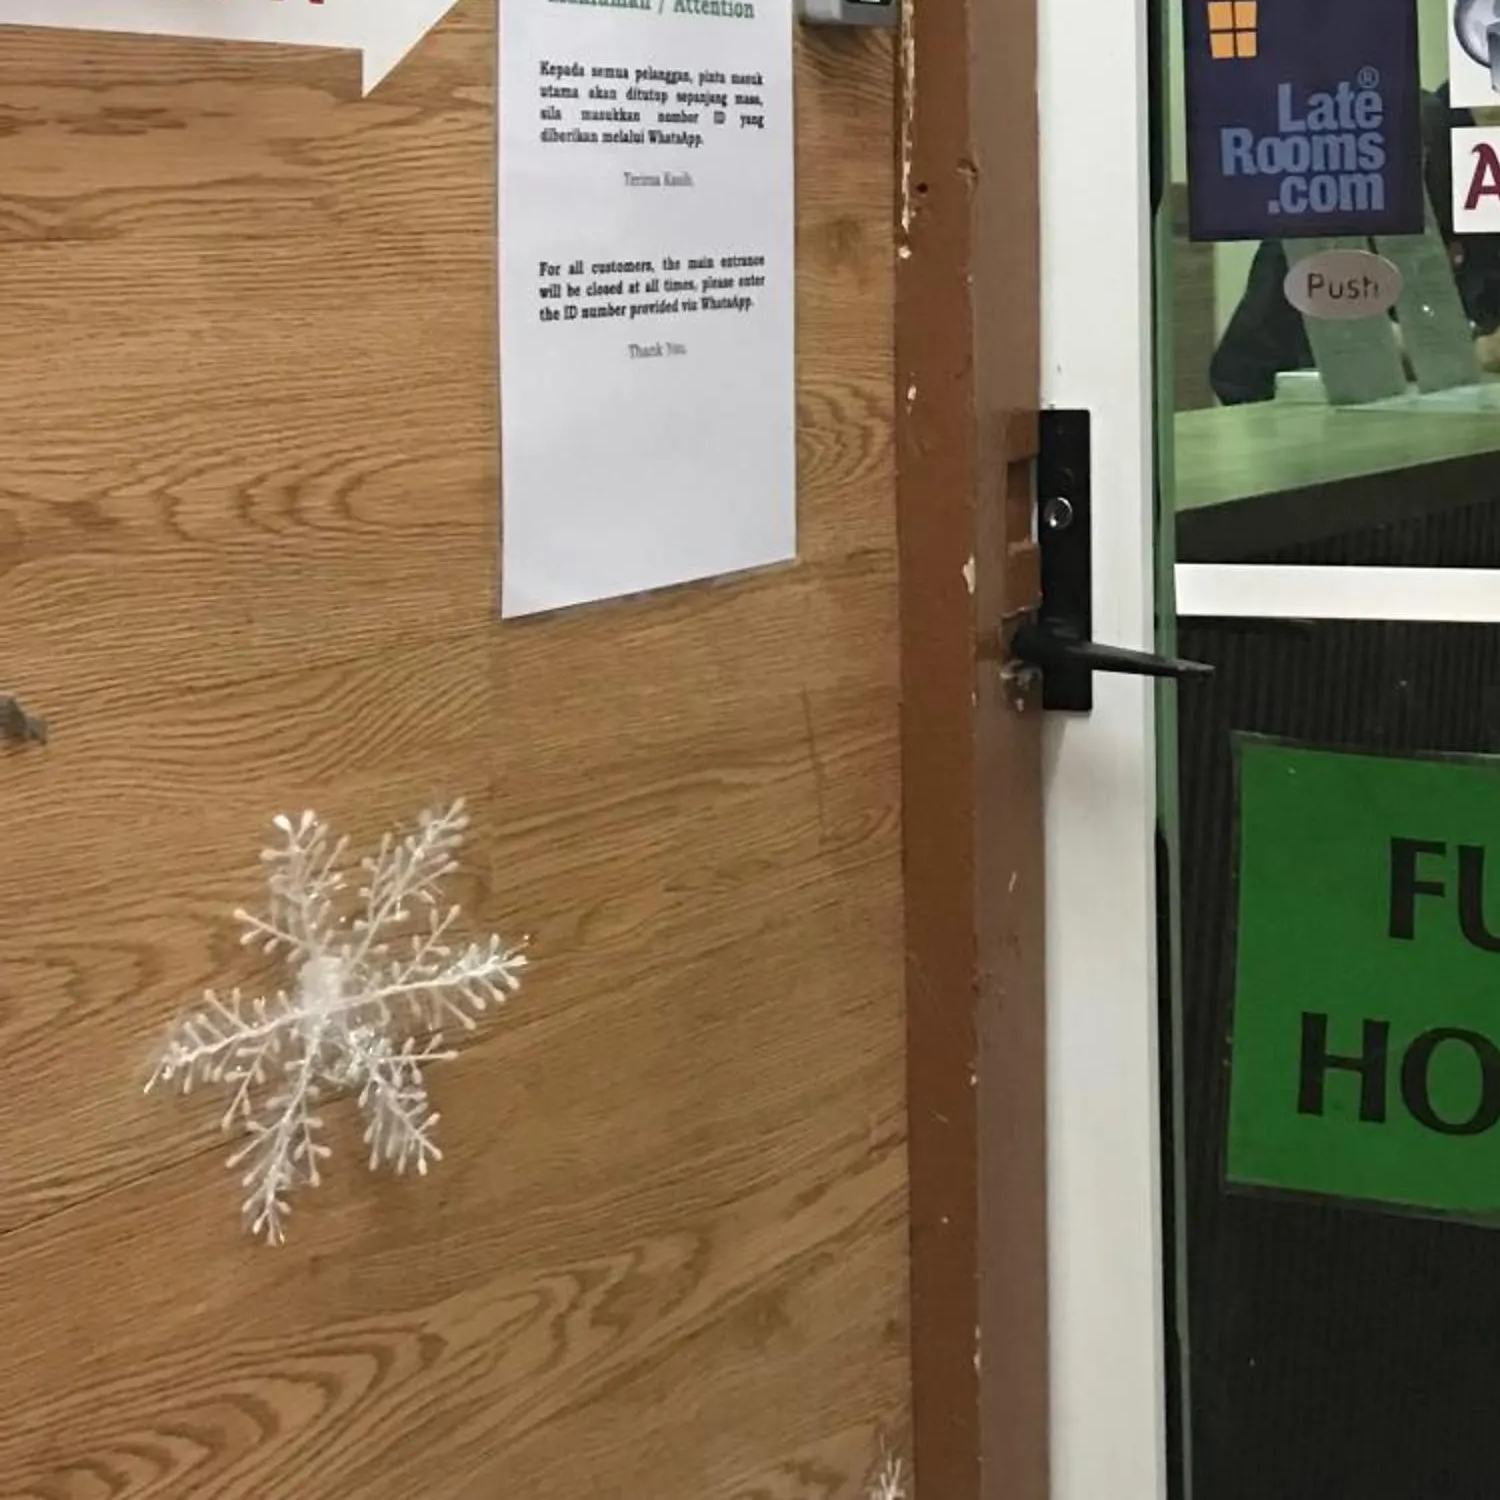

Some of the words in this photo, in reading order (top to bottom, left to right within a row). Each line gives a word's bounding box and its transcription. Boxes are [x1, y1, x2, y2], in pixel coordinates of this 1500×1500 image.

[539, 61, 585, 79] Kepada
[592, 66, 629, 79] semua
[698, 71, 726, 86] pintu
[731, 72, 763, 85] masuk
[540, 85, 579, 98] utama
[588, 87, 617, 100] akan
[626, 86, 668, 103] ditutup
[676, 92, 728, 107] sepanjang
[1277, 81, 1383, 133] Late
[540, 106, 562, 120] sila
[581, 107, 640, 121] masukkan
[657, 109, 699, 123] nombor
[713, 111, 726, 124] ID
[740, 114, 764, 128] yang
[540, 128, 598, 143] diberikan
[602, 130, 644, 143] melalui
[1220, 127, 1386, 176] Rooms
[624, 171, 661, 186] Terima
[1268, 172, 1385, 214] .com
[539, 261, 561, 277] For
[568, 260, 584, 275] all
[663, 257, 680, 271] the
[688, 256, 714, 269] main
[720, 255, 765, 268] entrance
[539, 284, 561, 298] will
[567, 283, 581, 297] be
[586, 281, 623, 296] closed
[628, 281, 640, 294] at
[645, 279, 659, 293] all
[702, 275, 734, 293] please
[738, 274, 765, 288] enter
[1306, 272, 1380, 301] Push
[540, 306, 560, 322] the
[564, 305, 578, 320] ID
[581, 302, 626, 319] number
[630, 299, 678, 320] provided
[682, 299, 697, 312] via
[628, 342, 662, 359] Thank
